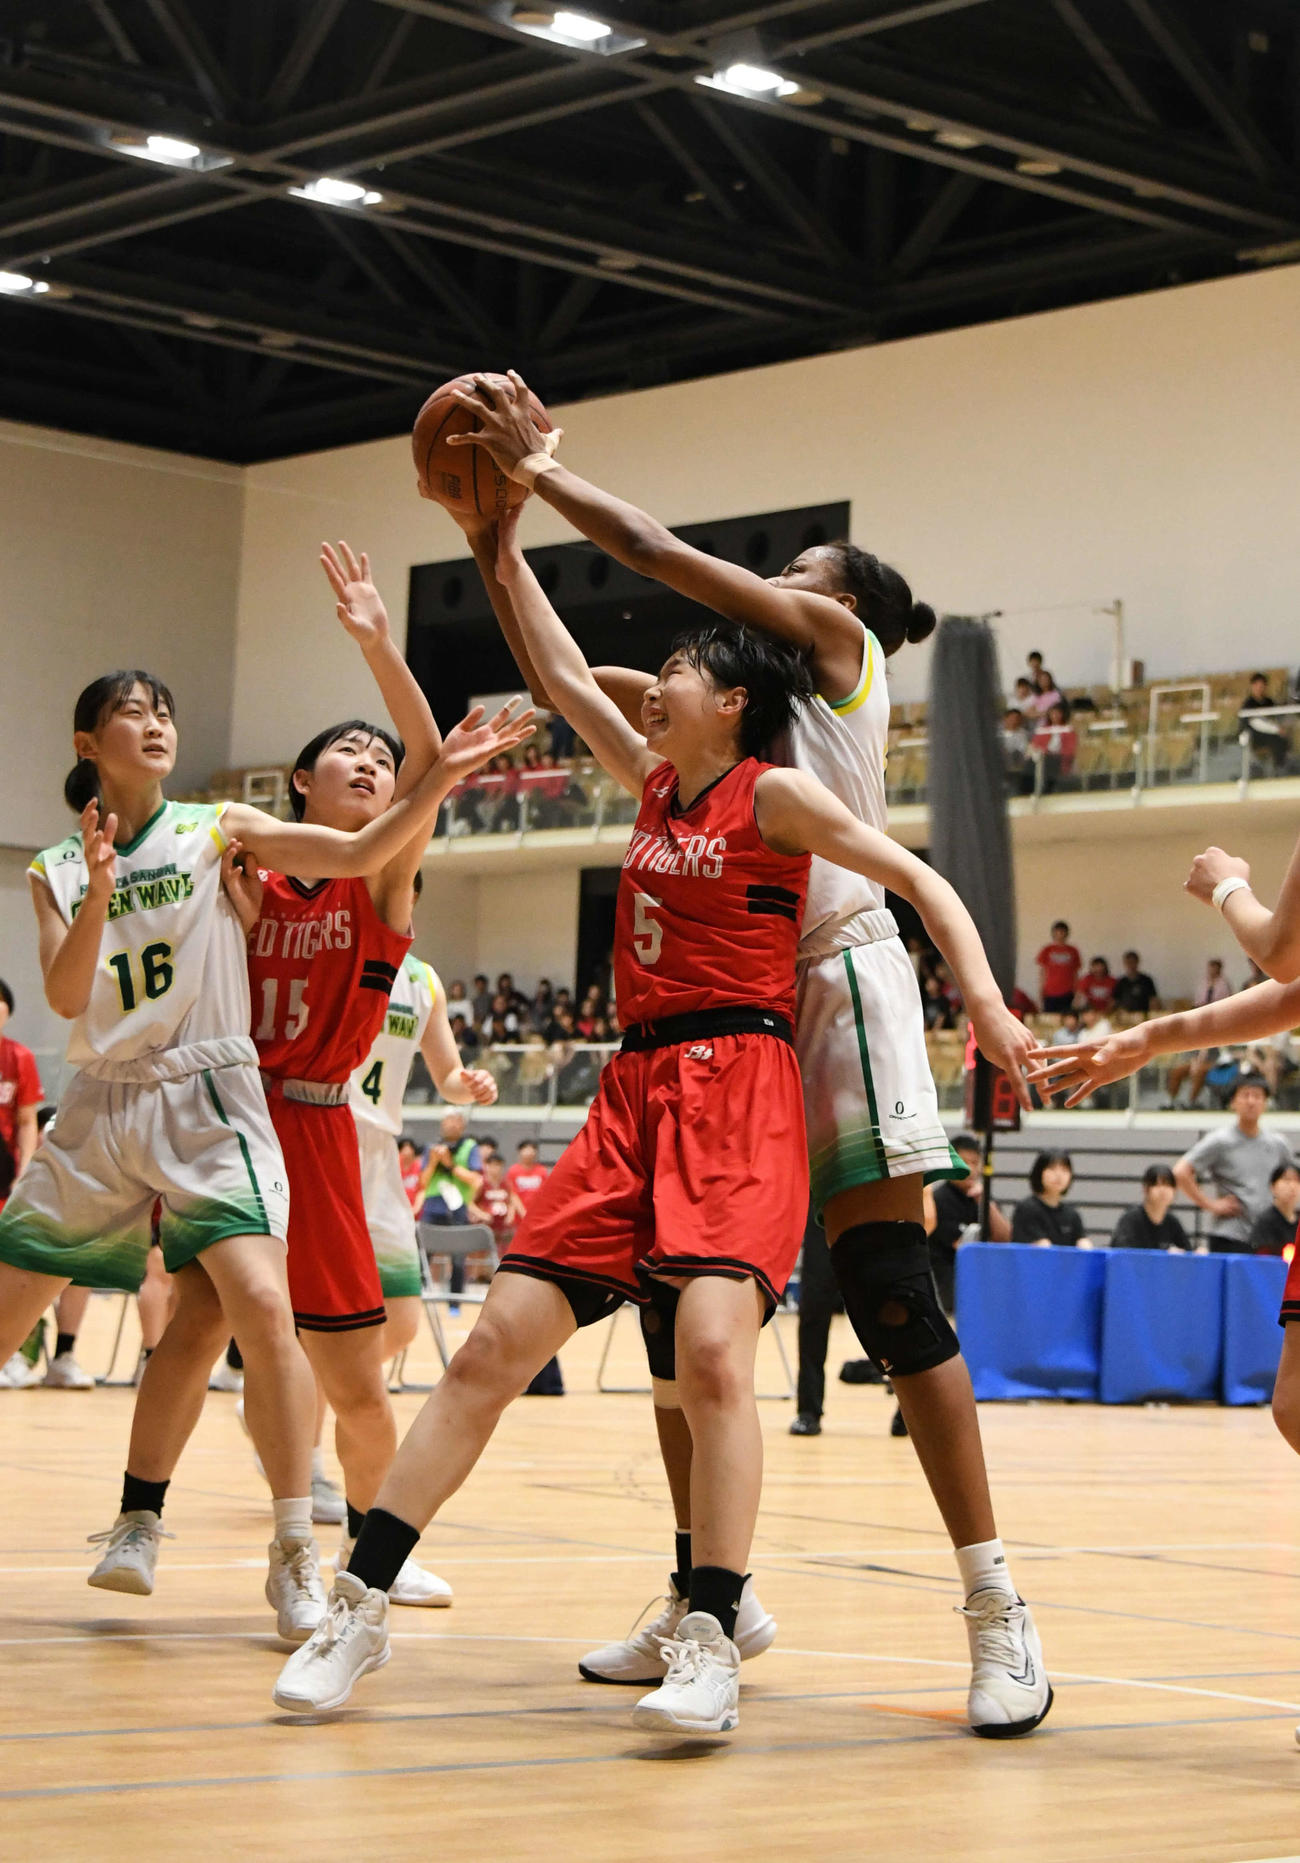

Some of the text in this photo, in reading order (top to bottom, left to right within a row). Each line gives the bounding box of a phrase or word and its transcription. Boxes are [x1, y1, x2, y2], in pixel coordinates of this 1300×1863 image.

[633, 892, 664, 965] 5
[106, 940, 175, 1014] 16
[255, 975, 311, 1041] 15
[387, 1013, 418, 1040] WAV
[359, 1058, 385, 1107] 4
